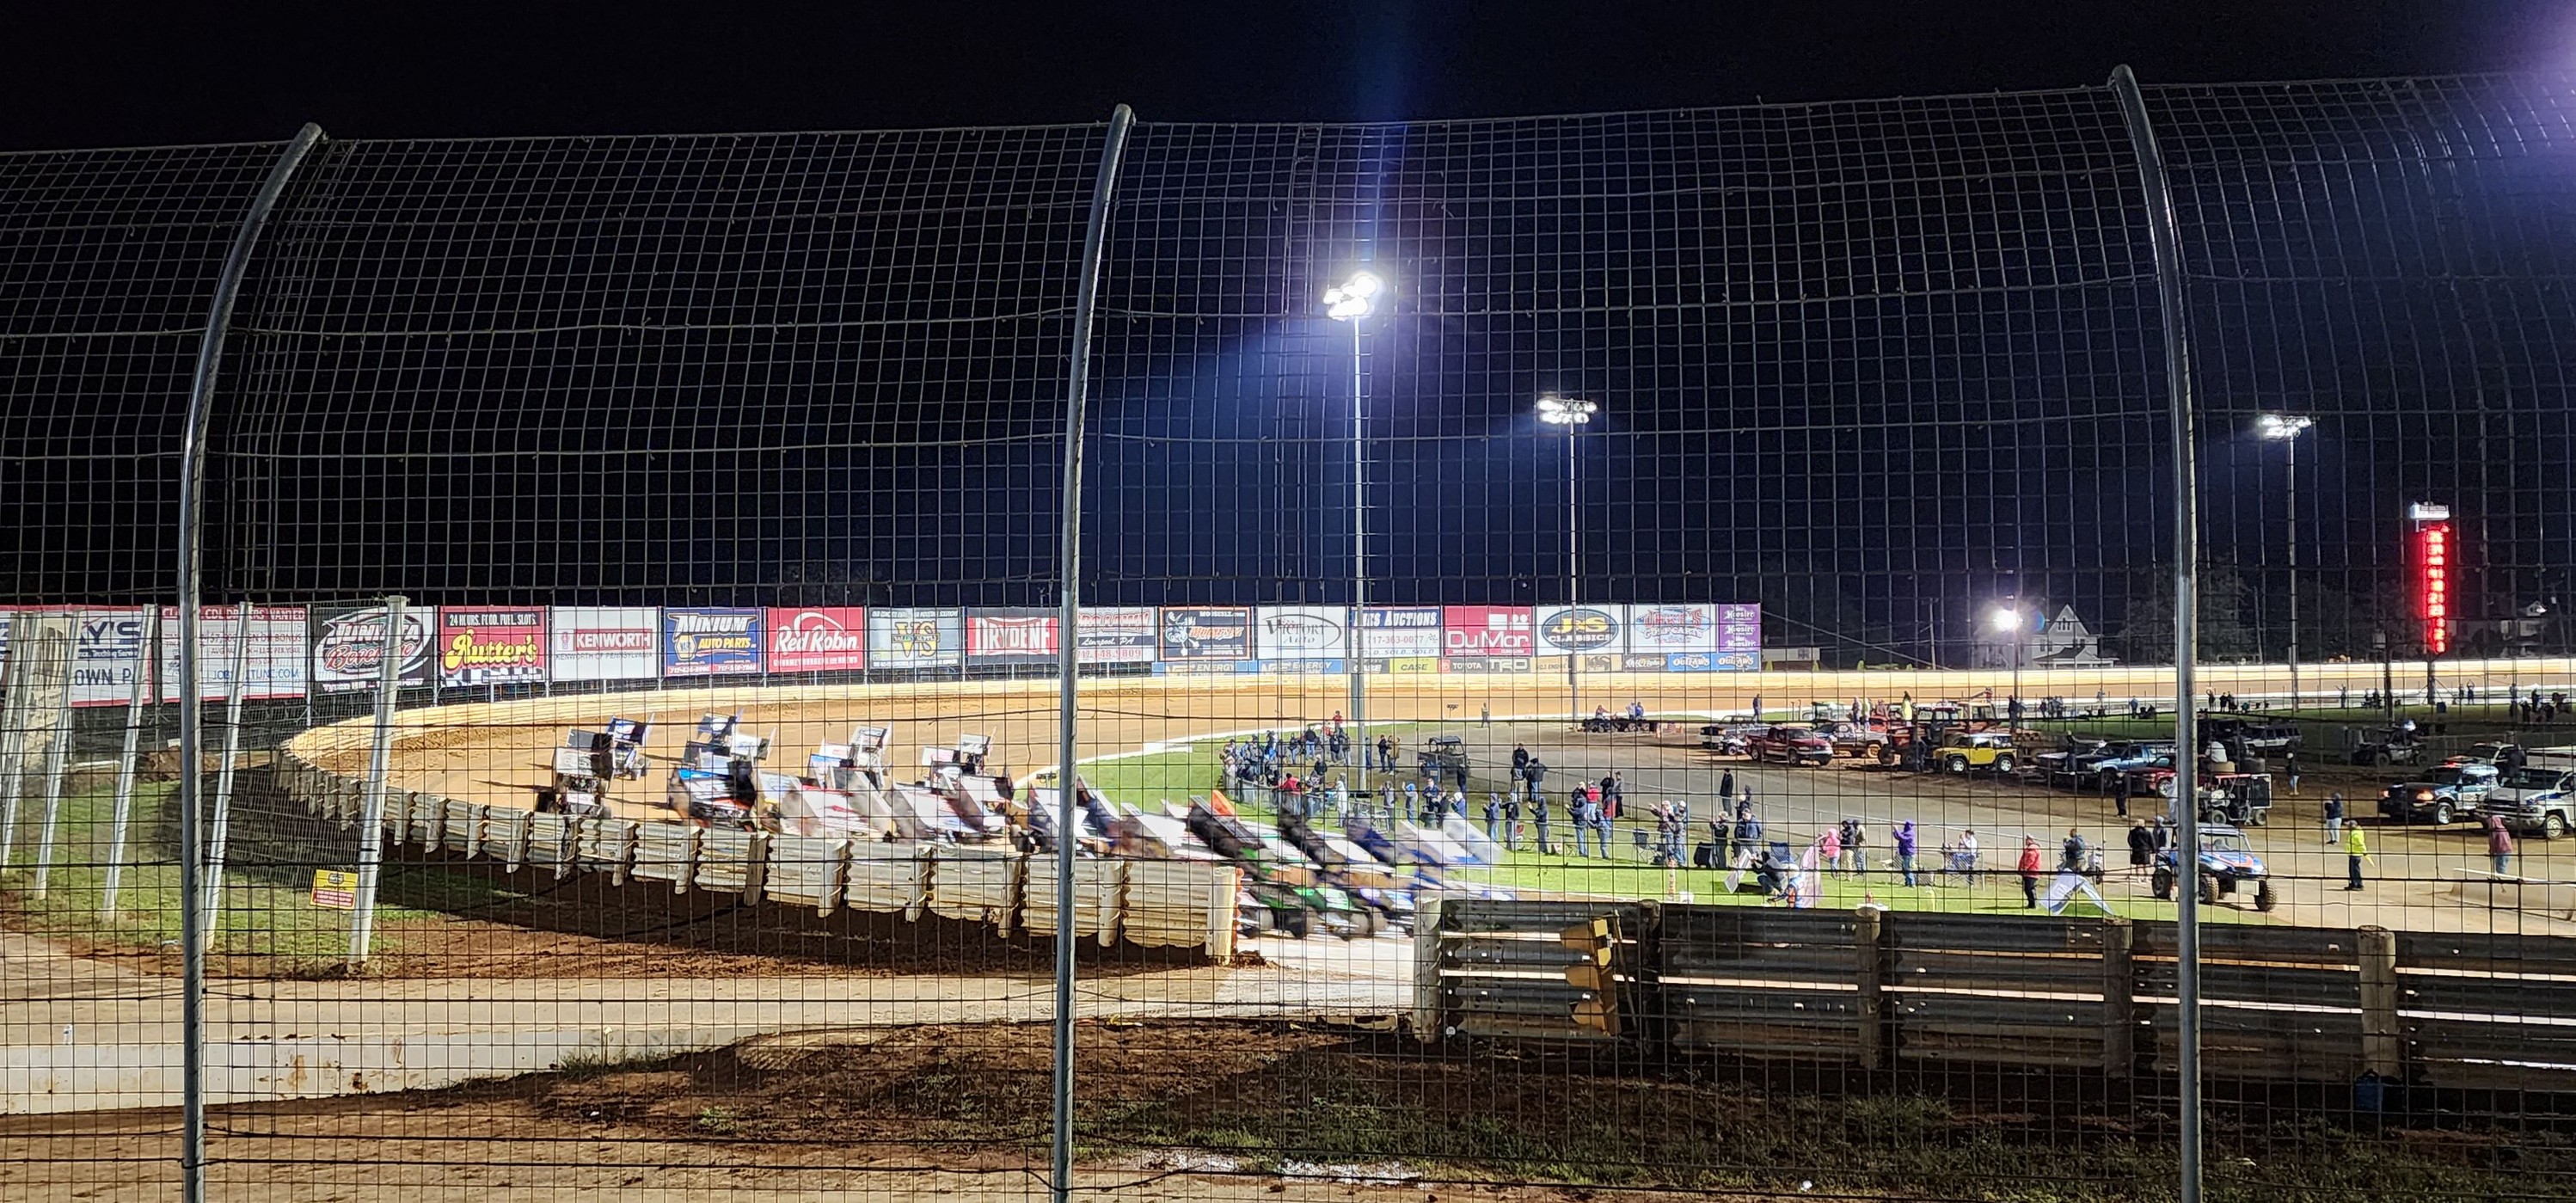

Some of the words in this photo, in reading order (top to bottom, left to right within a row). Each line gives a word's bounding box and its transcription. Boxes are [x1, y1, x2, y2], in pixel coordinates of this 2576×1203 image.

[1384, 611, 1438, 626] AUCTIONS
[326, 623, 420, 647] JUNITA
[577, 633, 652, 648] KENWORTH
[810, 624, 859, 652] Robin
[895, 620, 937, 660] VS
[1120, 636, 1135, 646] PA
[1447, 630, 1530, 649] DuMor
[445, 628, 538, 670] Rutter's
[698, 638, 722, 649] AUTO
[723, 637, 751, 648] PARTS
[1197, 663, 1234, 672] ENERGY
[1353, 663, 1382, 672] CSE
[1401, 663, 1428, 672] CASE
